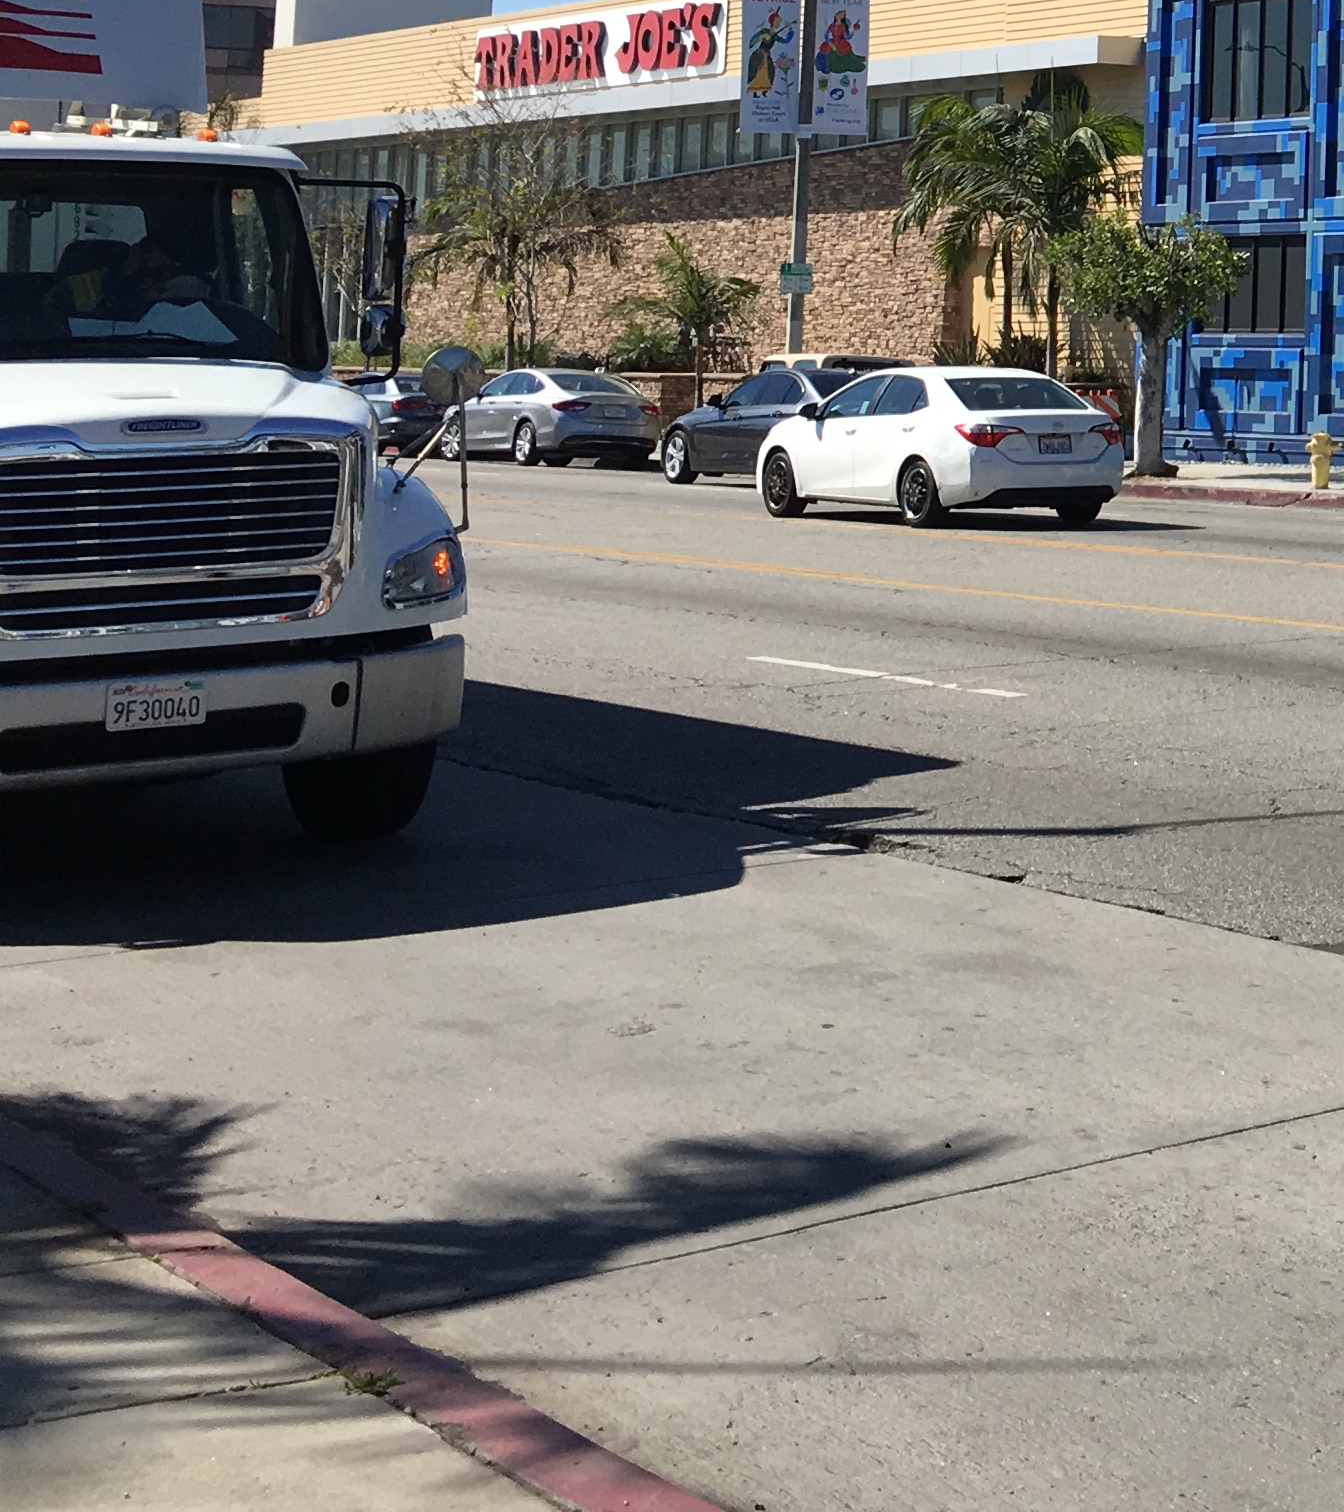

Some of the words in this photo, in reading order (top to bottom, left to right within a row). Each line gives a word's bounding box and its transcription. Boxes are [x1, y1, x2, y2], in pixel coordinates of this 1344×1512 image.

[475, 21, 606, 90] TRADER
[614, 2, 724, 75] JOE'S
[113, 695, 200, 725] 9F30040
